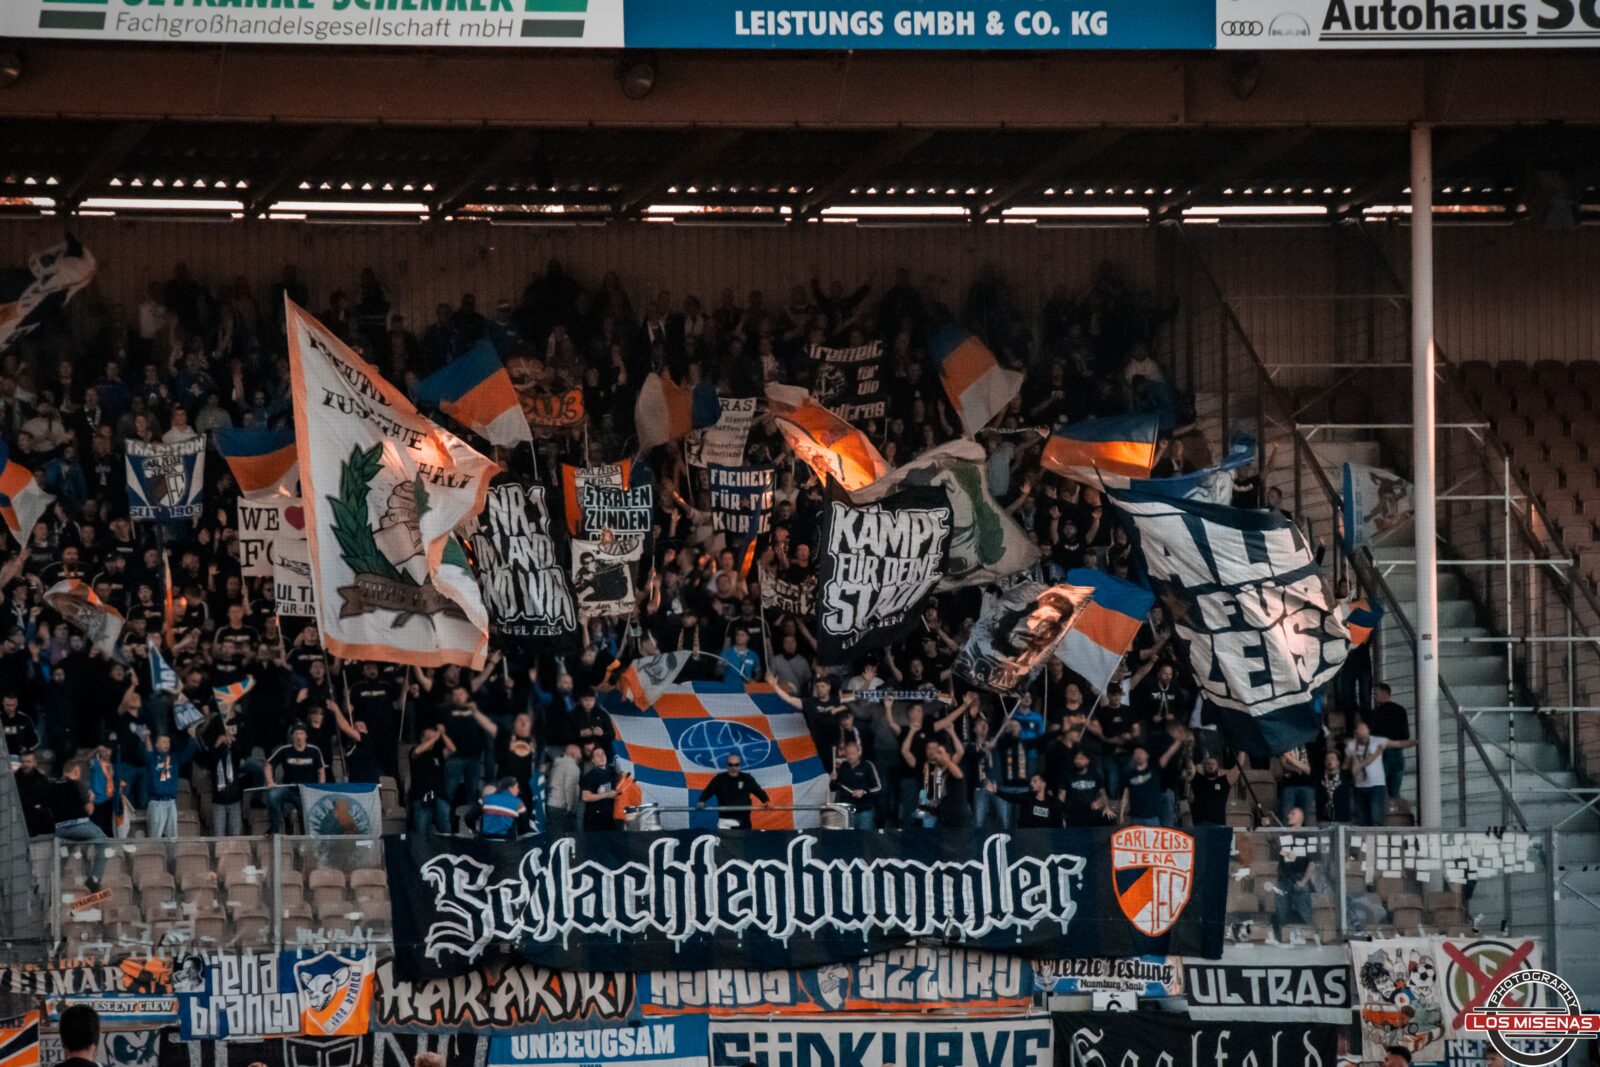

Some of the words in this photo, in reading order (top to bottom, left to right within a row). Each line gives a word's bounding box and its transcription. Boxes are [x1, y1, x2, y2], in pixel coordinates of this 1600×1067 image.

[116, 12, 450, 40] Fachgroßhandelsgesellschaft
[459, 18, 514, 38] mbH
[735, 10, 885, 36] LEISTUNGS
[893, 10, 979, 36] GMBH
[986, 11, 1006, 36] &
[1012, 11, 1061, 36] CO.
[1069, 10, 1108, 36] KG
[1322, 0, 1527, 31] Autohaus
[126, 436, 205, 456] TRADITION
[711, 469, 774, 487] FREIHEIT
[584, 484, 653, 508] STRAFEN
[711, 489, 740, 511] FÜR
[240, 506, 280, 531] WE
[585, 506, 651, 531] ZÜNDEN
[830, 503, 949, 558] KÄMPF
[836, 548, 880, 591] FÜR
[1115, 832, 1148, 850] CARL
[1151, 830, 1190, 850] ZEISS
[1129, 852, 1177, 866] JENA
[421, 833, 1087, 962] Schlachtenbummler
[1188, 967, 1347, 1005] ULTRAS
[138, 1001, 174, 1013] CREW
[189, 993, 301, 1035] branco
[511, 1024, 676, 1060] UNBEUGSAM
